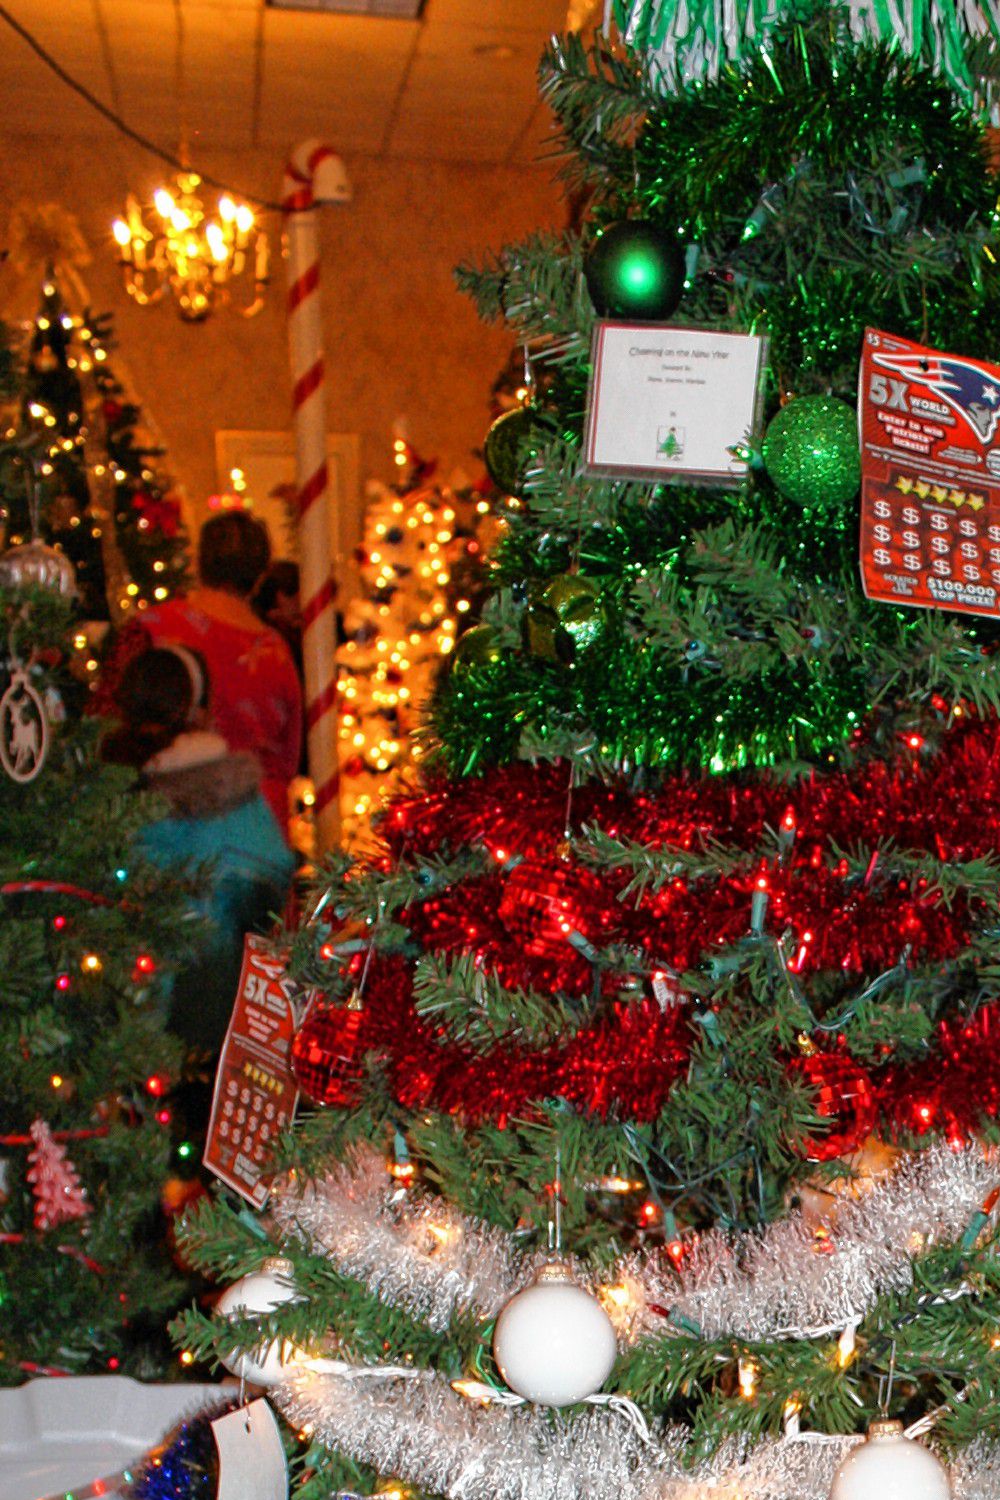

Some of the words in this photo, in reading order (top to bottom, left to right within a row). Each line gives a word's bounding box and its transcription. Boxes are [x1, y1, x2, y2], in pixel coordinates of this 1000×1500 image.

[869, 373, 909, 412] 5X
[909, 395, 950, 416] WORLD
[878, 410, 907, 427] Enter
[908, 420, 921, 431] to
[923, 425, 944, 438] win
